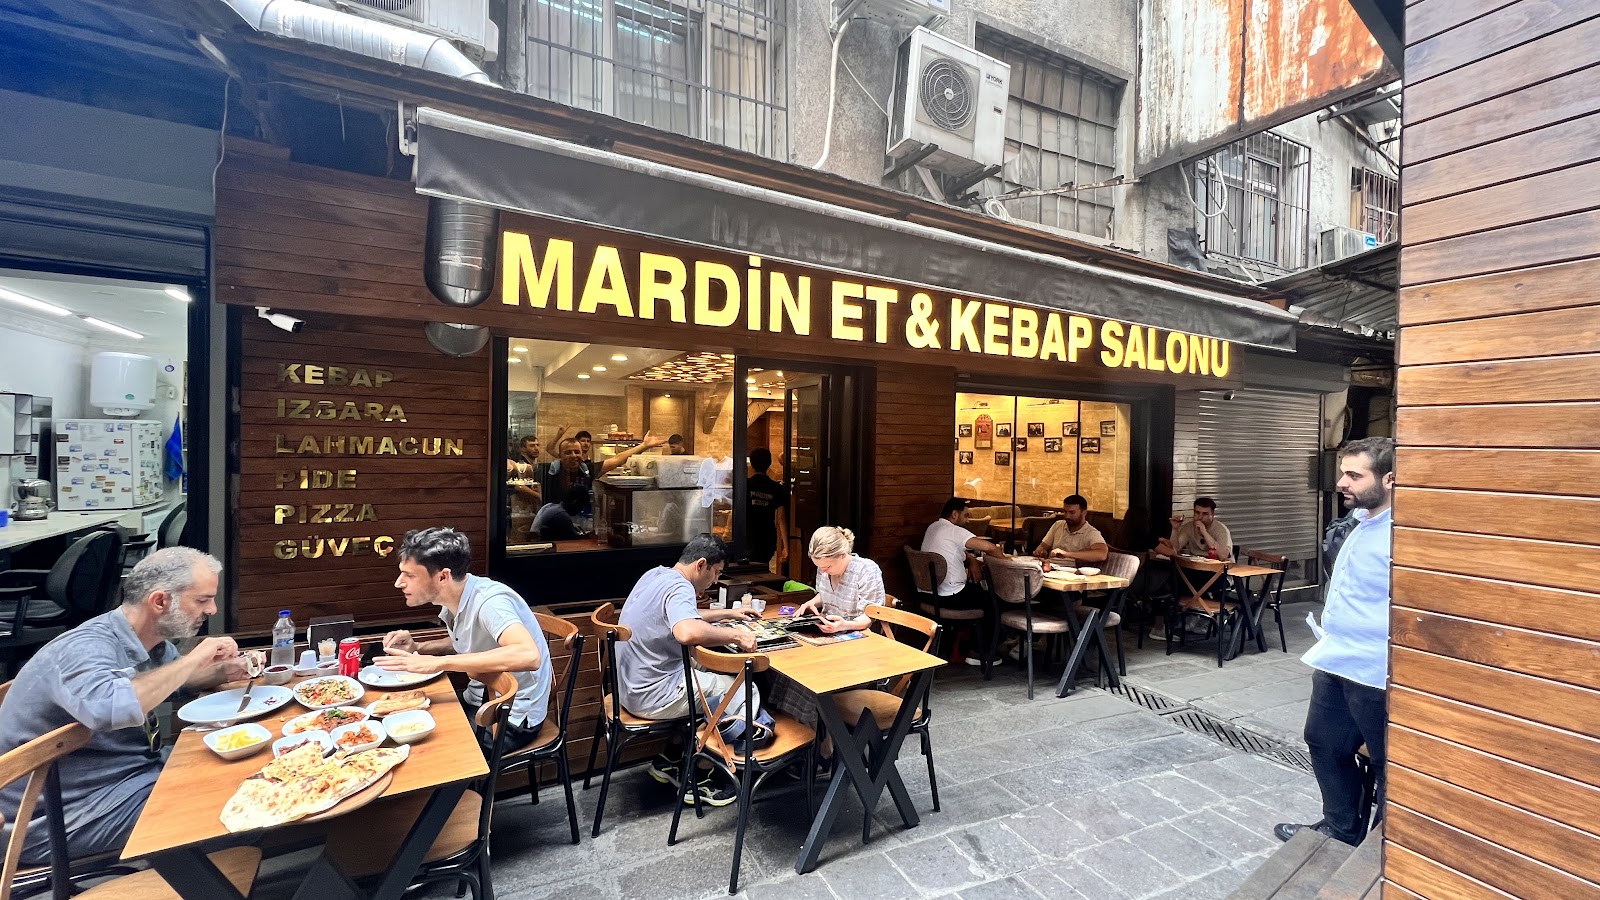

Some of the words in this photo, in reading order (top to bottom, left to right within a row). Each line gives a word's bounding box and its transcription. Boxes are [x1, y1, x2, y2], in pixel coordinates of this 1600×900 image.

[502, 231, 810, 335] MARDİN
[831, 280, 898, 344] ET
[905, 292, 941, 350] &
[950, 298, 1093, 363] KEBAP
[1100, 319, 1230, 378] SALONU
[278, 363, 394, 388] KEBAP
[276, 398, 408, 423] IZGARA
[275, 434, 464, 456] LAHMACUN
[275, 466, 357, 489] PİDE
[274, 501, 379, 525] PİZZA
[273, 535, 394, 560] GÜVEÇ
